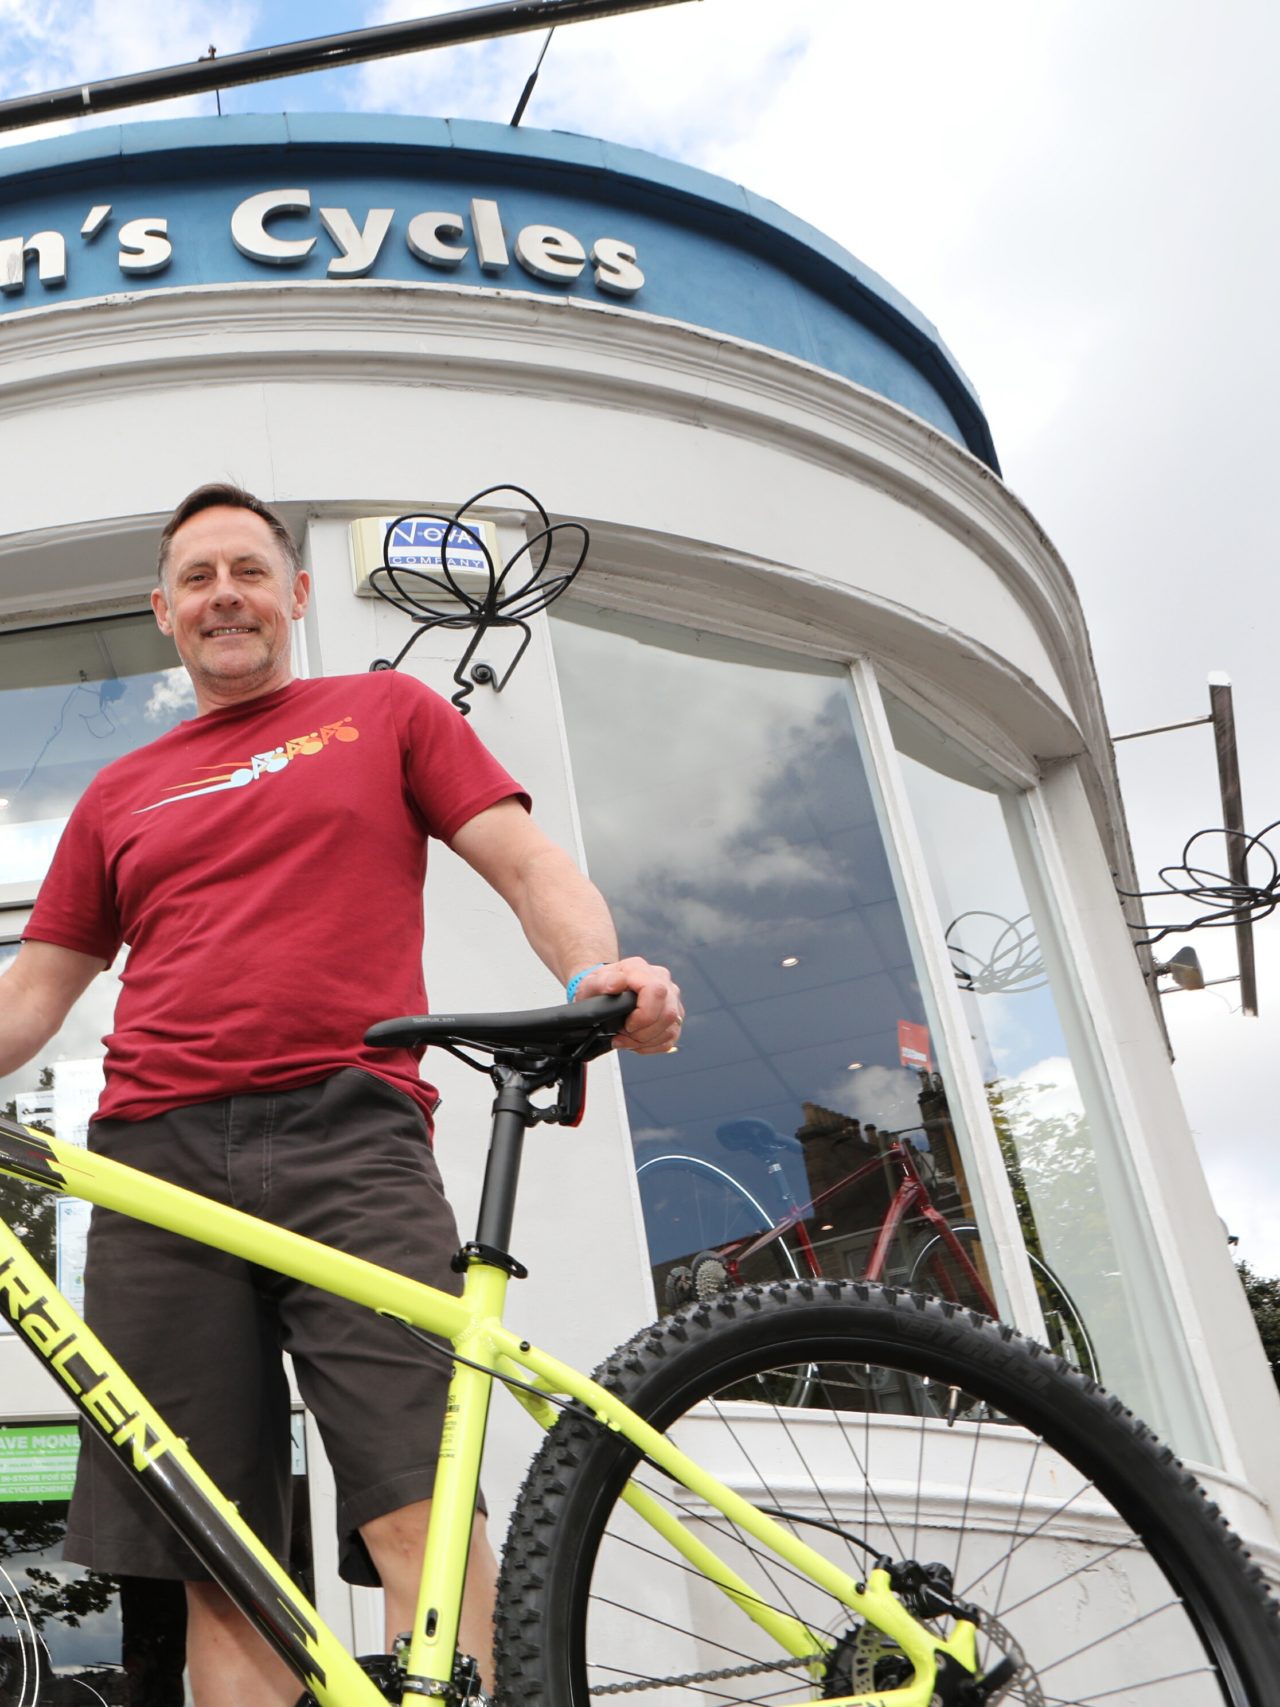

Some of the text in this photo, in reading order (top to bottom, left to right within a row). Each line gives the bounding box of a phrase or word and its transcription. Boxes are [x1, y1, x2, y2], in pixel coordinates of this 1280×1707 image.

[231, 189, 645, 295] Cycles
[392, 556, 483, 568] COMPANY
[31, 1433, 82, 1449] MONE
